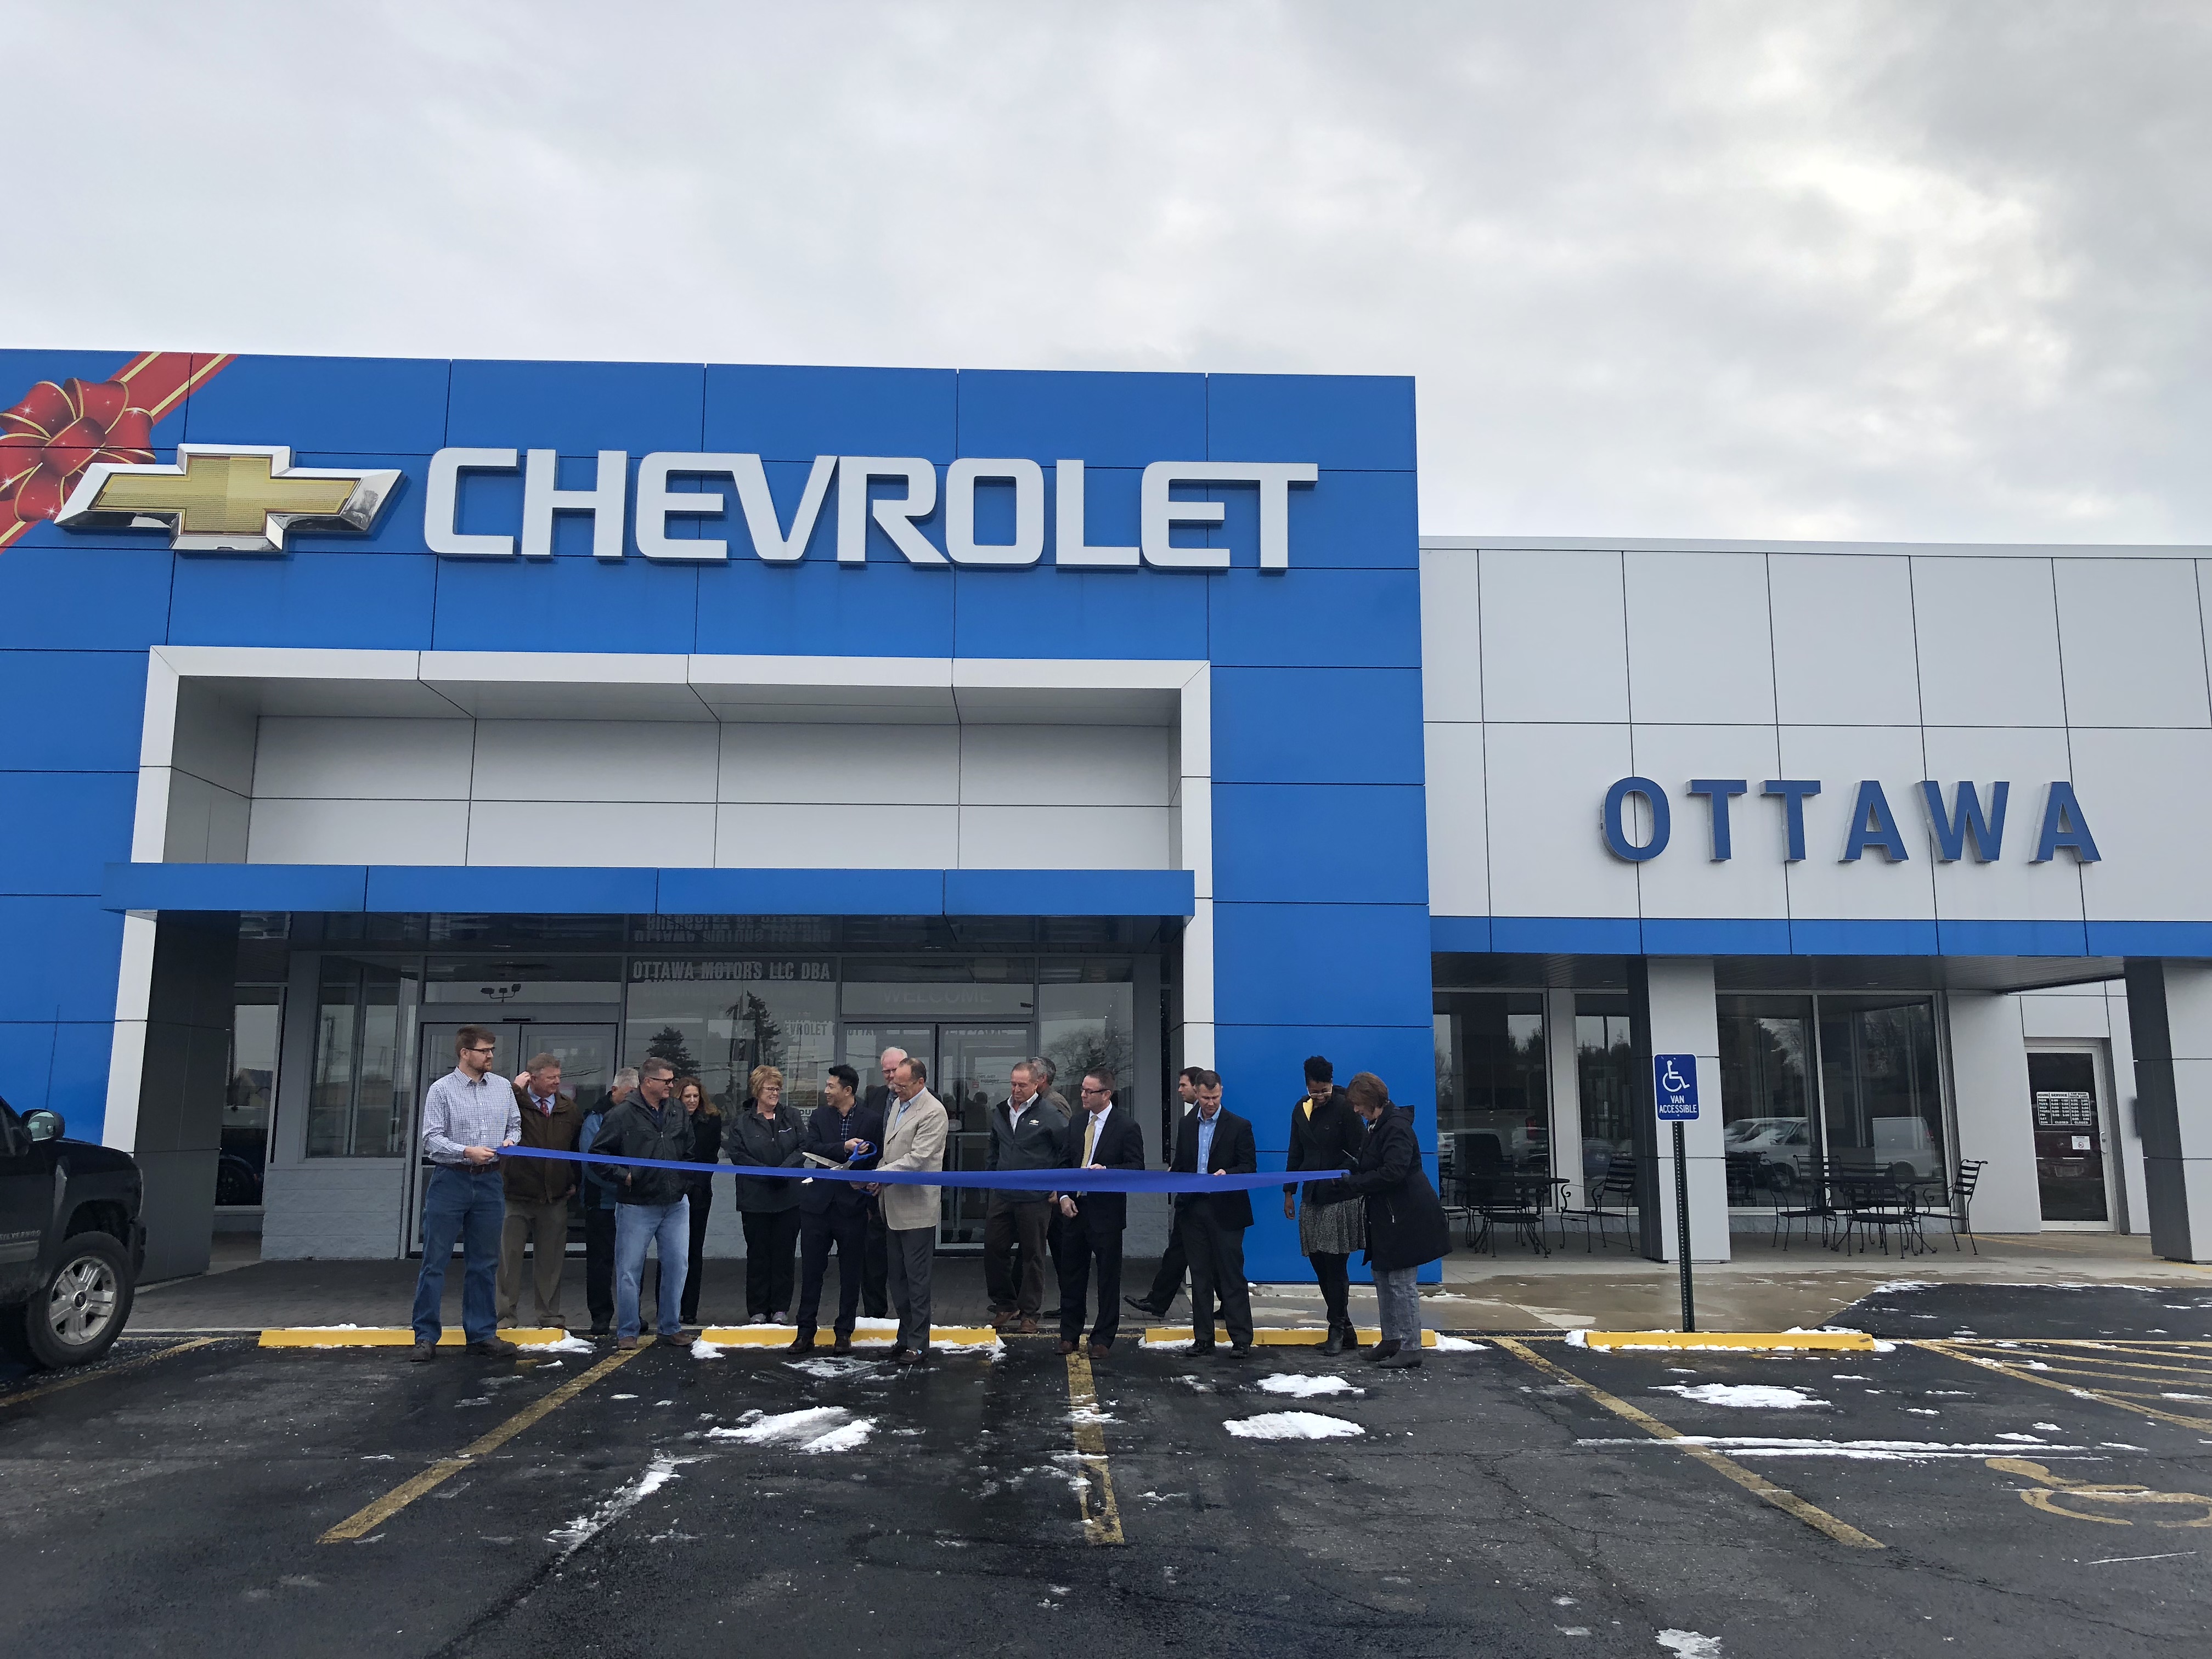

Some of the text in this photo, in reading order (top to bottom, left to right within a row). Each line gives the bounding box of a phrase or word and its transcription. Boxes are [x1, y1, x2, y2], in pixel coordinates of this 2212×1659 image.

[424, 447, 1319, 572] CHEVROLET
[1600, 776, 2102, 864] OTTAWA
[633, 961, 830, 980] OTTAWA MOTORS LLC DBA
[883, 987, 992, 1003] WELCOME
[1670, 1095, 1685, 1104] VAN
[1659, 1104, 1697, 1113] ACCESSIBLE
